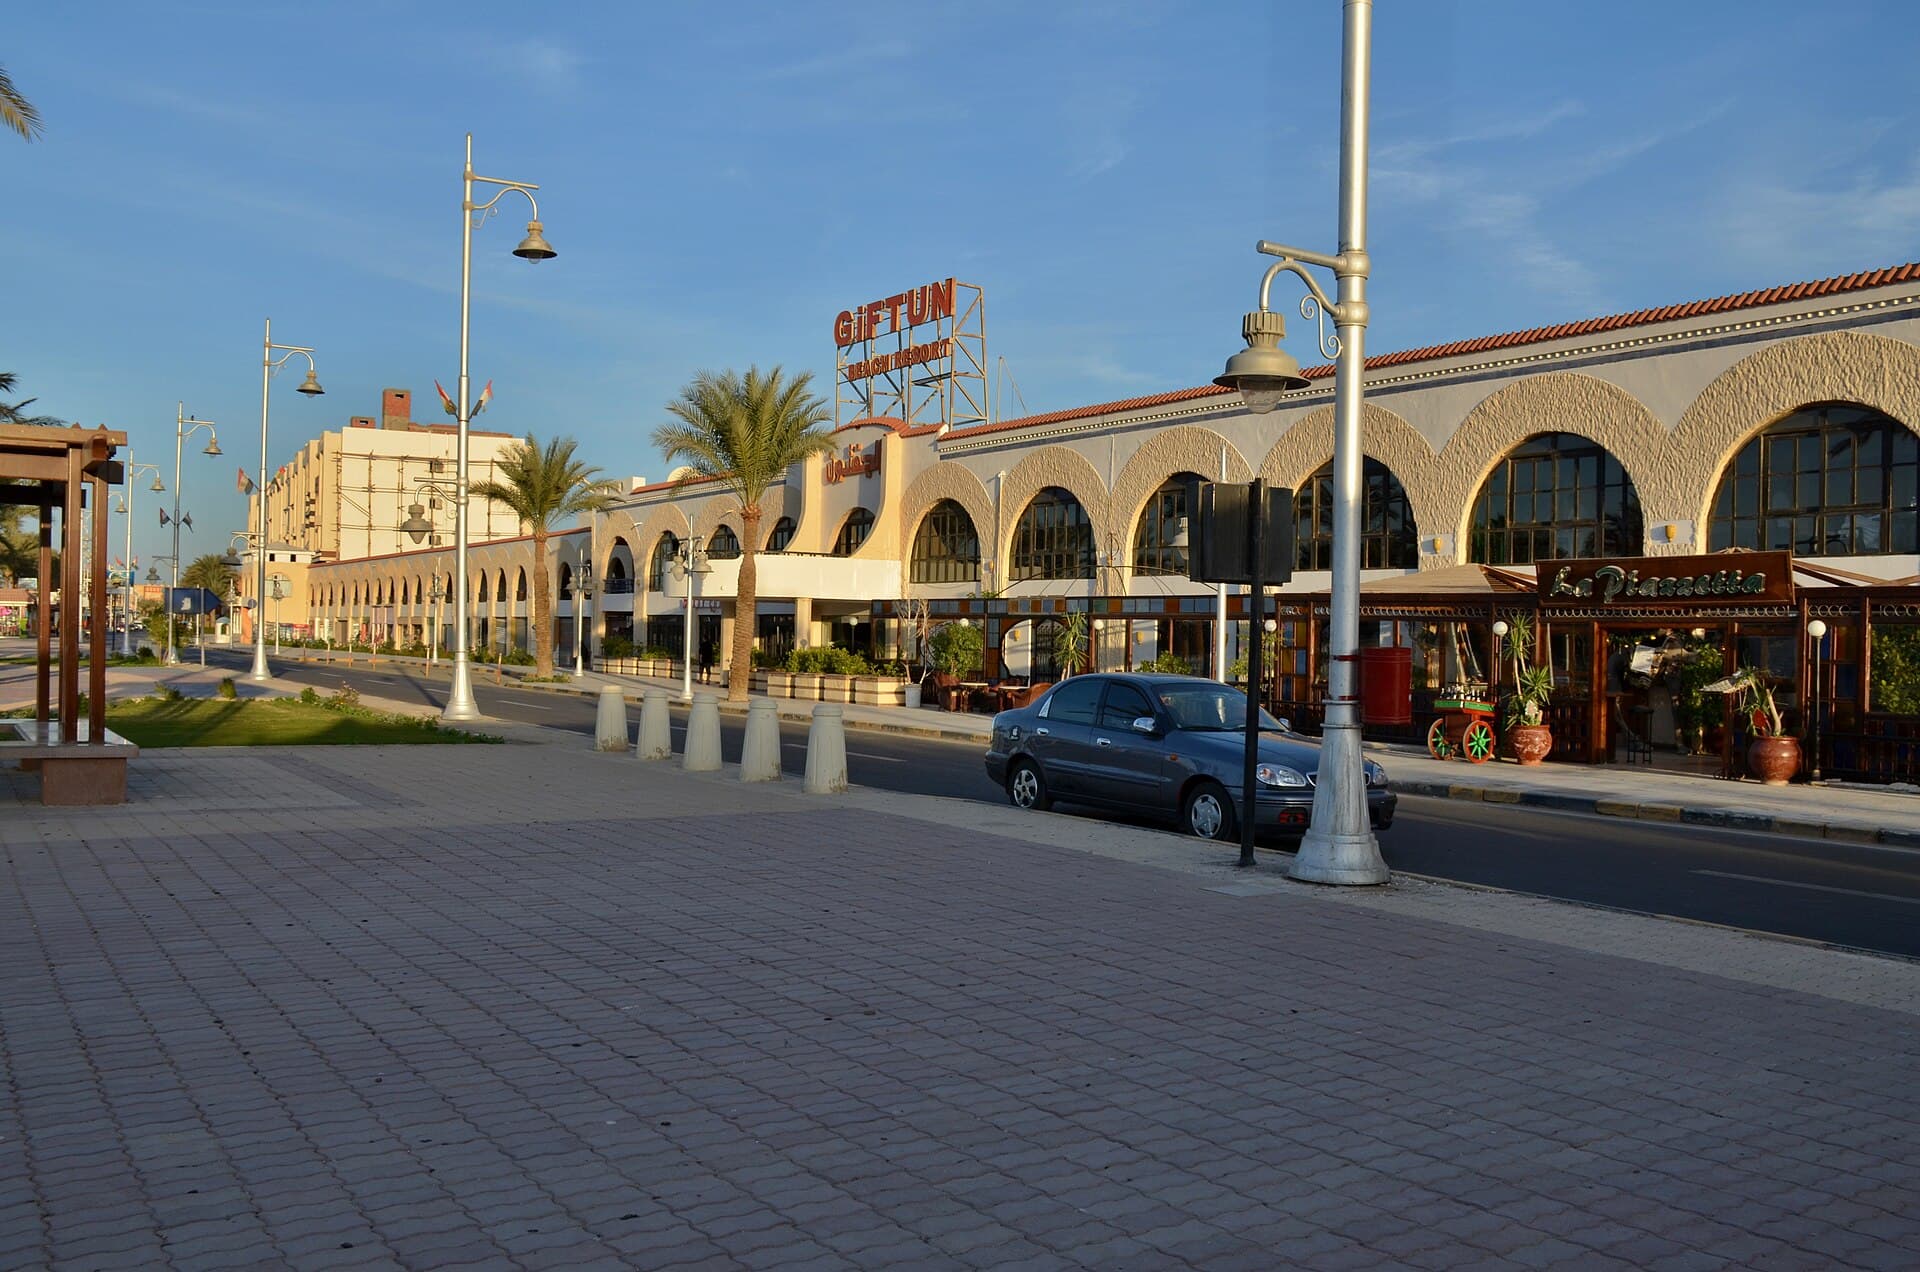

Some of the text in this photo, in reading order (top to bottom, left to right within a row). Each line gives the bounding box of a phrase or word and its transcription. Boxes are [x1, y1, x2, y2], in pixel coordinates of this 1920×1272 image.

[848, 338, 953, 382] BEACH RESORT
[1550, 565, 1766, 604] La Piazzetta
